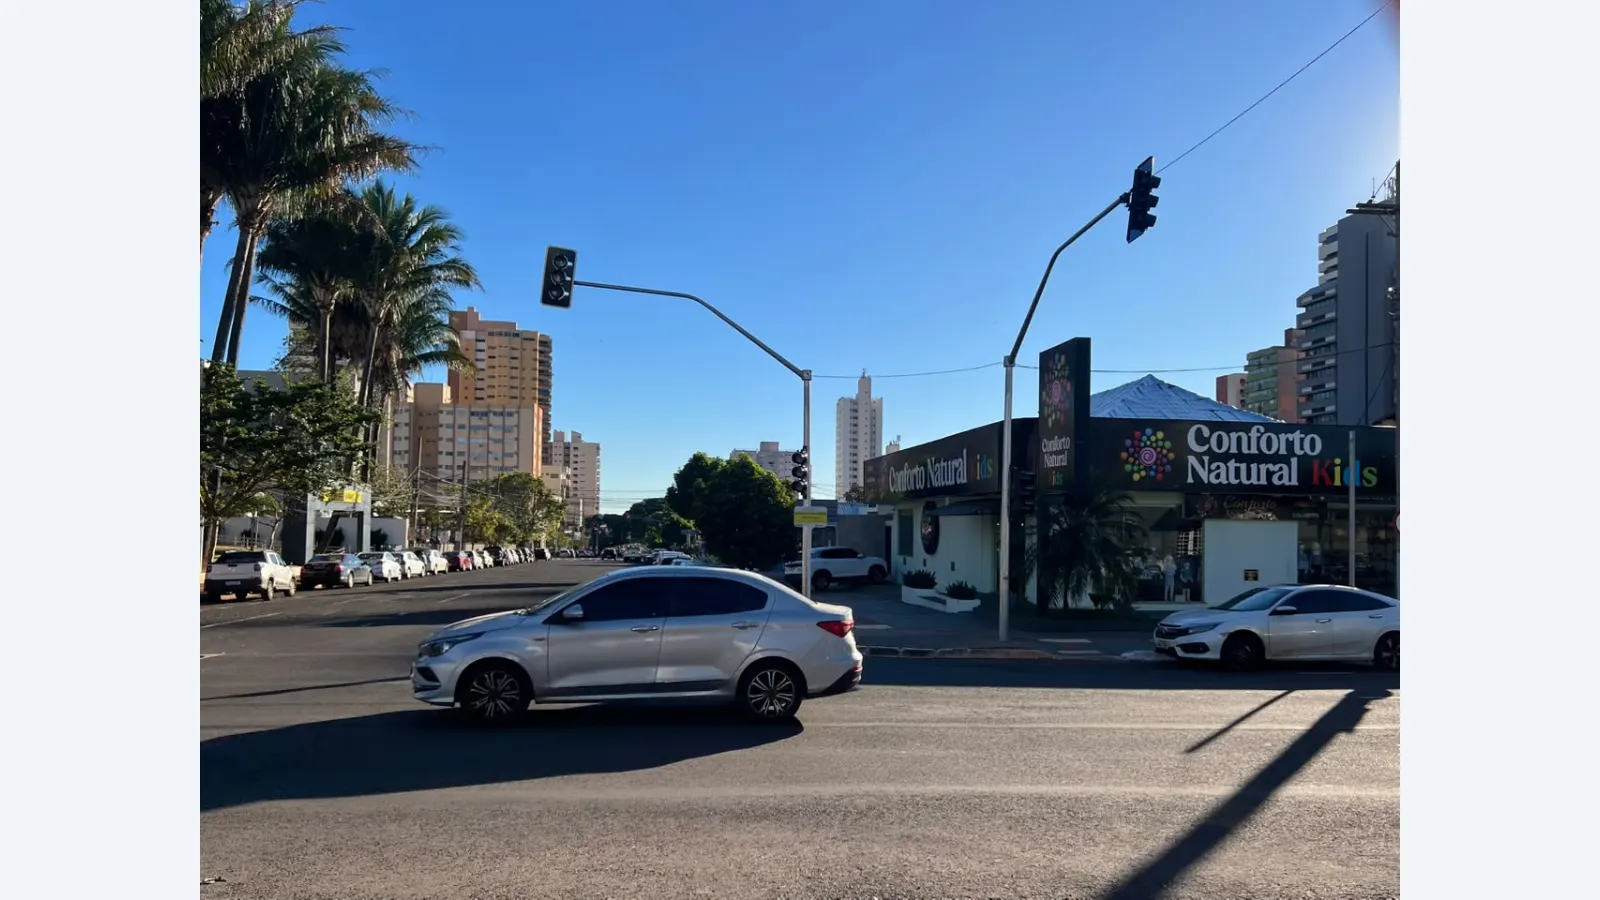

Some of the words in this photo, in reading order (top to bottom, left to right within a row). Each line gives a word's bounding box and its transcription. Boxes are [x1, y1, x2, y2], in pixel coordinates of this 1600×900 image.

[1041, 435, 1070, 452] Conforto
[1187, 424, 1322, 455] Conforto
[889, 462, 925, 493] Conforto
[927, 448, 968, 488] Natural
[1044, 450, 1068, 468] Natural
[1186, 455, 1299, 486] Natural
[1312, 457, 1378, 488] Kids
